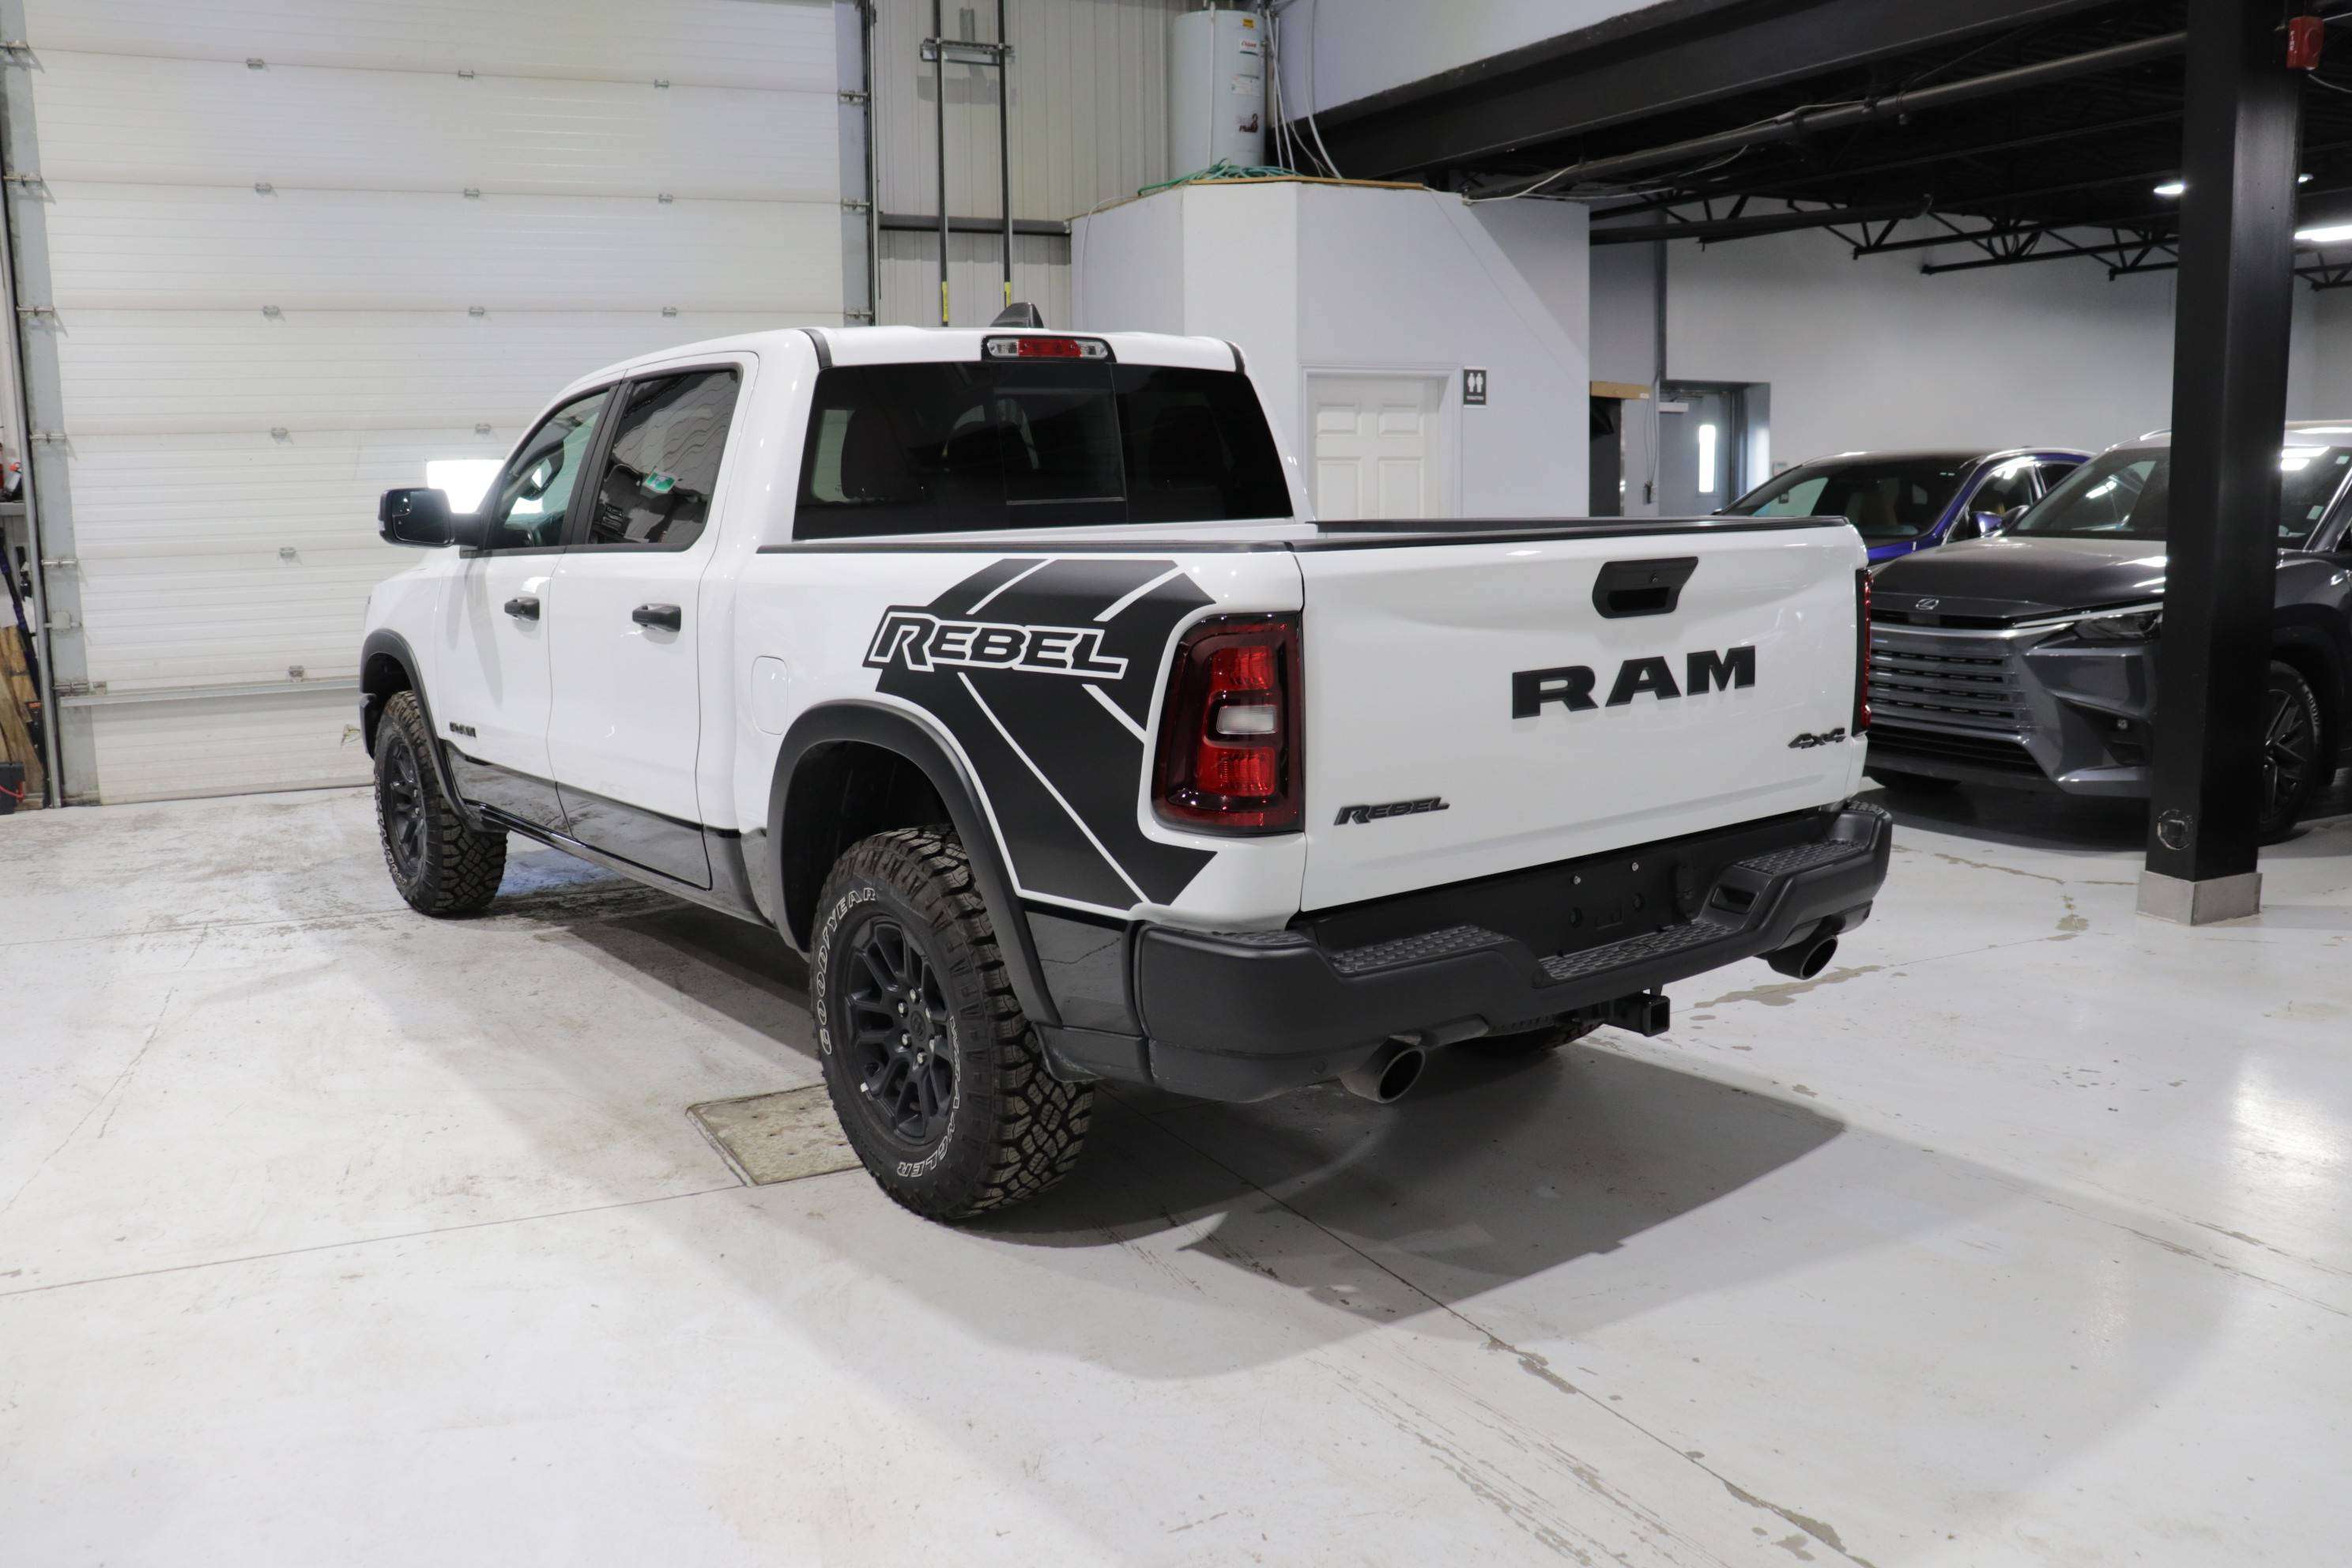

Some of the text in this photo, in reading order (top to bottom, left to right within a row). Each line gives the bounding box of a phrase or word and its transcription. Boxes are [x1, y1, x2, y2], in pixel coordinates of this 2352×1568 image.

[869, 612, 1129, 680] REBEL
[1512, 646, 1755, 718] RAM
[1788, 727, 1846, 749] 4x4
[1333, 797, 1450, 826] REBEL
[816, 887, 877, 1055] GOODYEAR
